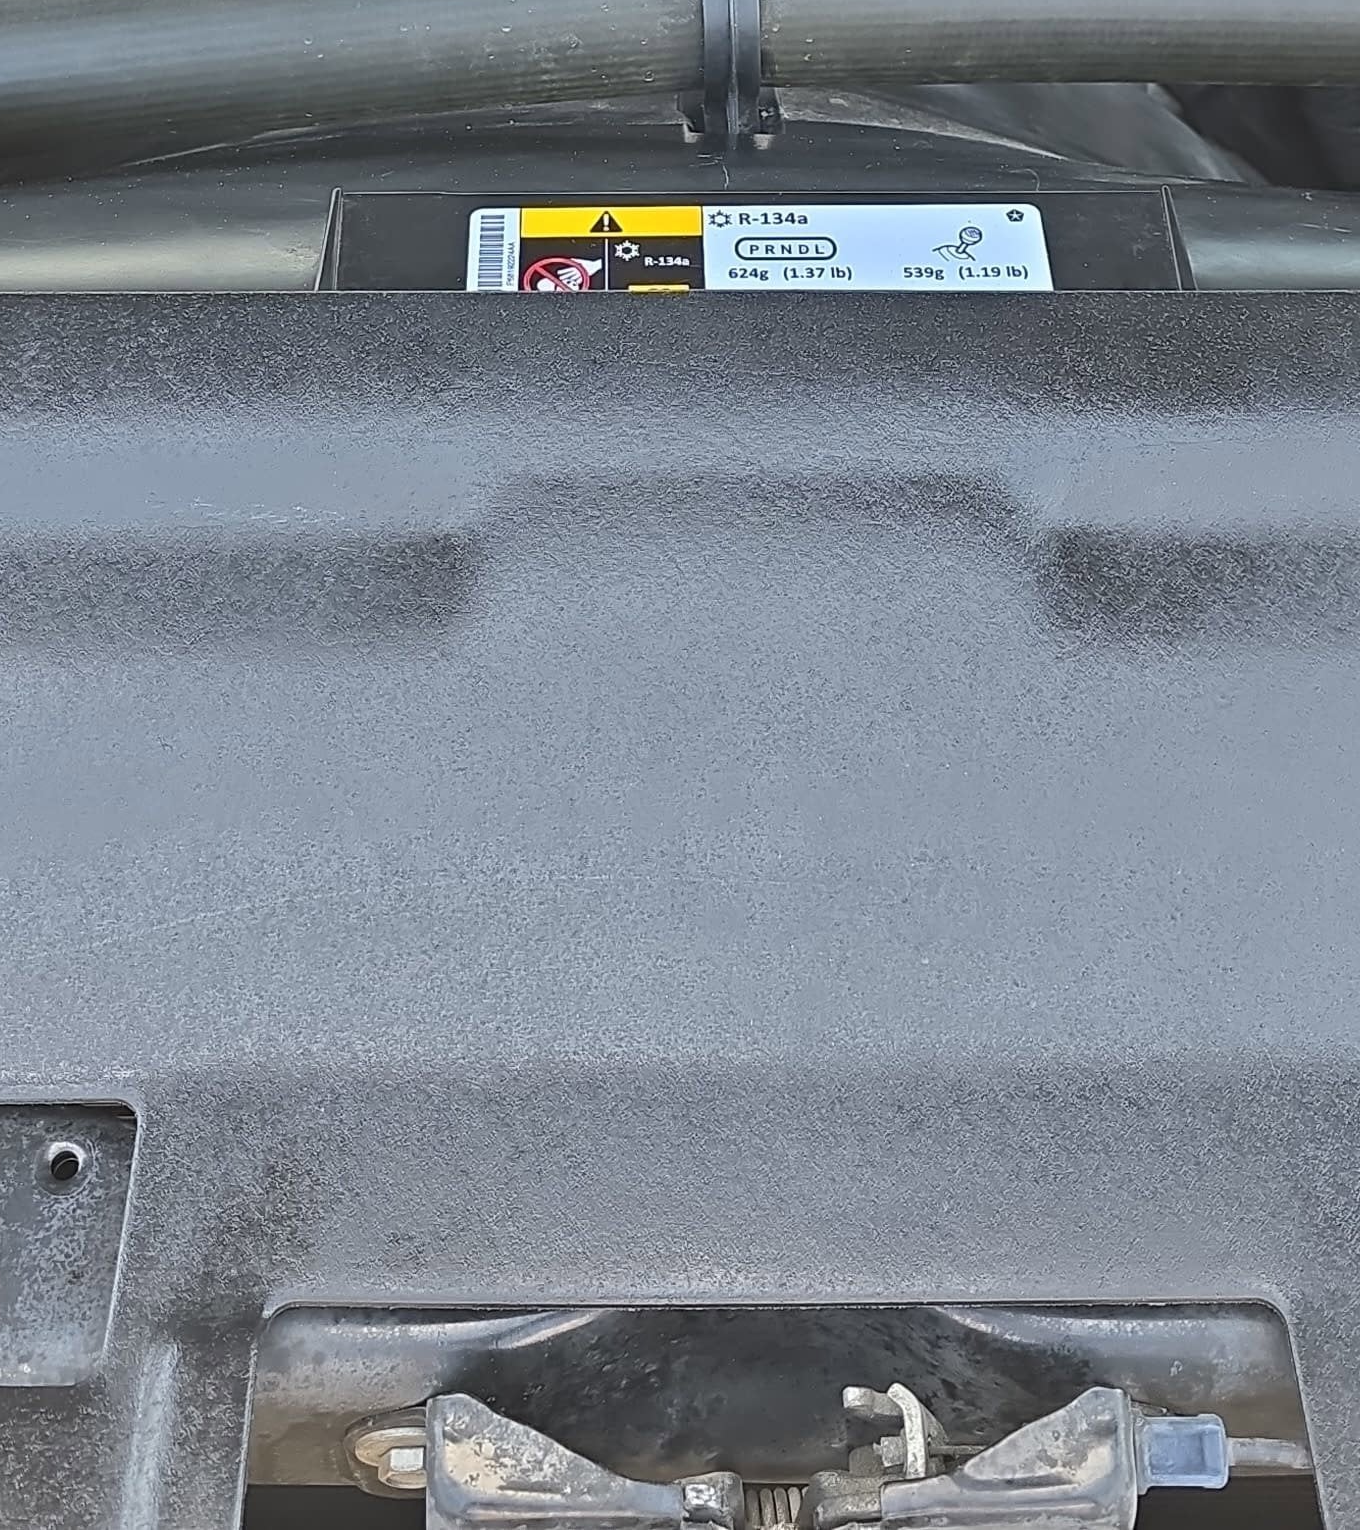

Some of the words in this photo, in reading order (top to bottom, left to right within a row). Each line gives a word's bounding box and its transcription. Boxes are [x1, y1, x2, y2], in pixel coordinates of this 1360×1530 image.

[738, 212, 809, 226] R-134a
[644, 256, 691, 267] R-134a
[728, 267, 770, 281] 624g
[783, 266, 826, 281] (1.37
[831, 266, 853, 281] lb)
[903, 266, 945, 281] 539g
[958, 266, 1002, 281] (1.19
[1006, 265, 1029, 280] lb)
